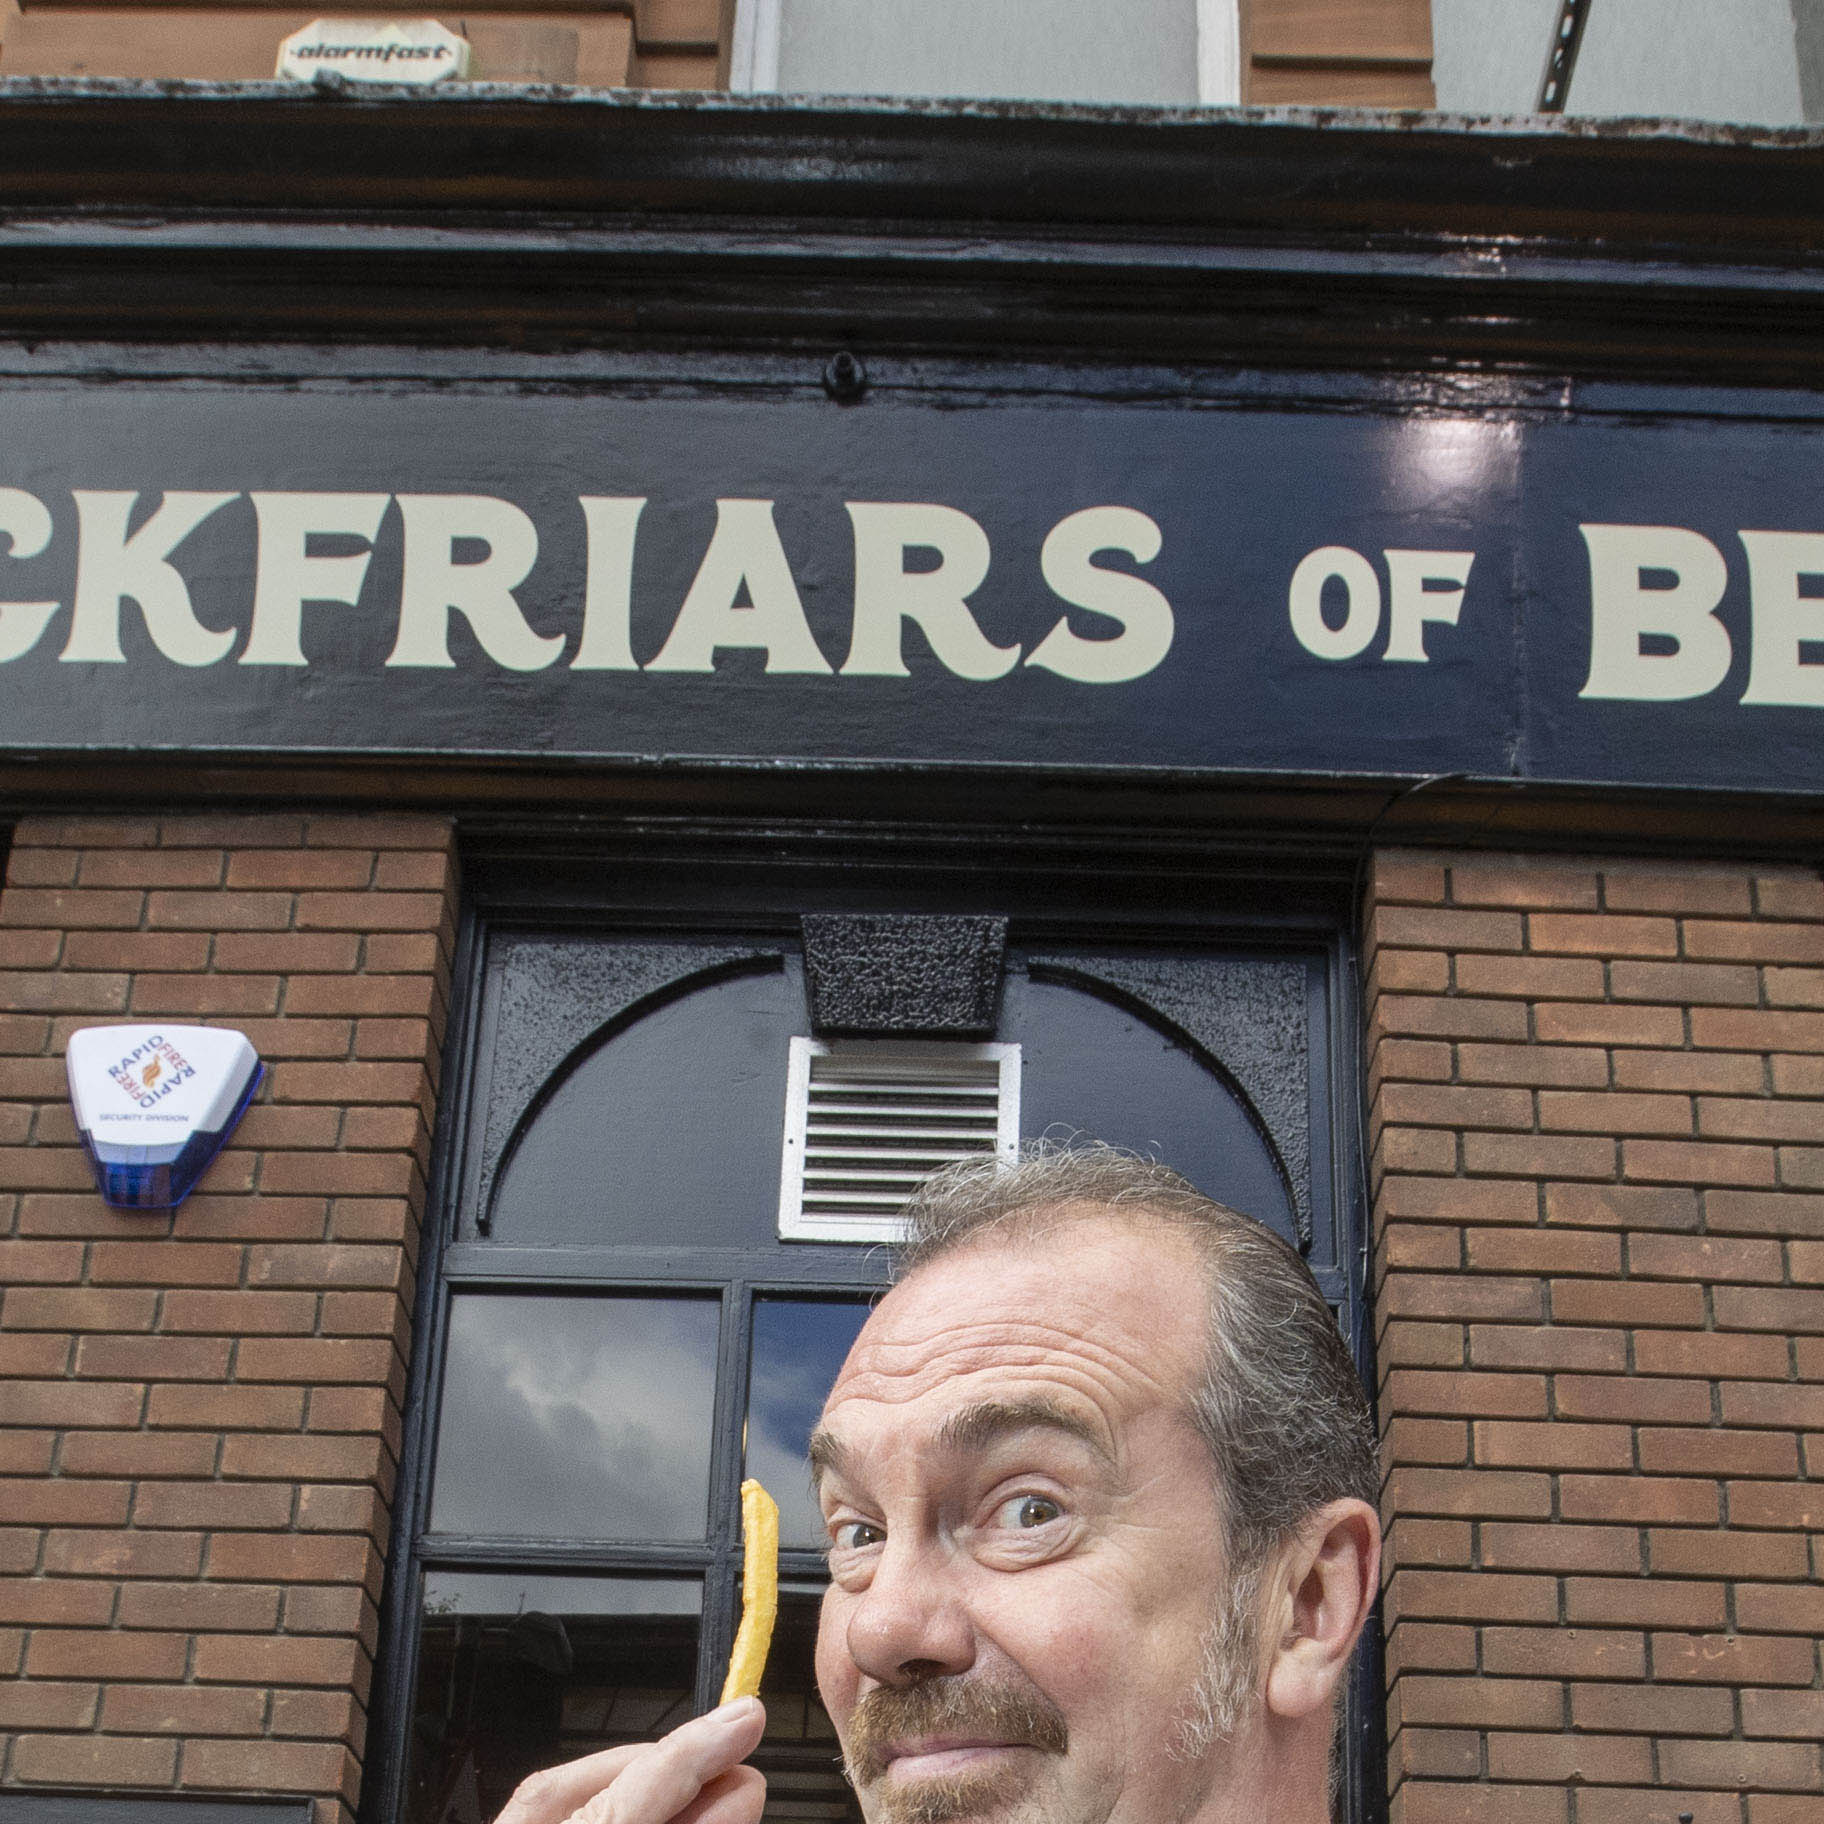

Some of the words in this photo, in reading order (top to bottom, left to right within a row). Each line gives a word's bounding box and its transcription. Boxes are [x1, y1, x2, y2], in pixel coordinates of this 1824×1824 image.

[1288, 545, 1475, 662] OF
[108, 1035, 163, 1078] RAPID
[157, 1042, 188, 1070] FIRE
[140, 1065, 196, 1108] RAPID
[99, 1113, 142, 1121] SECURITY
[145, 1114, 189, 1122] DIVISION
